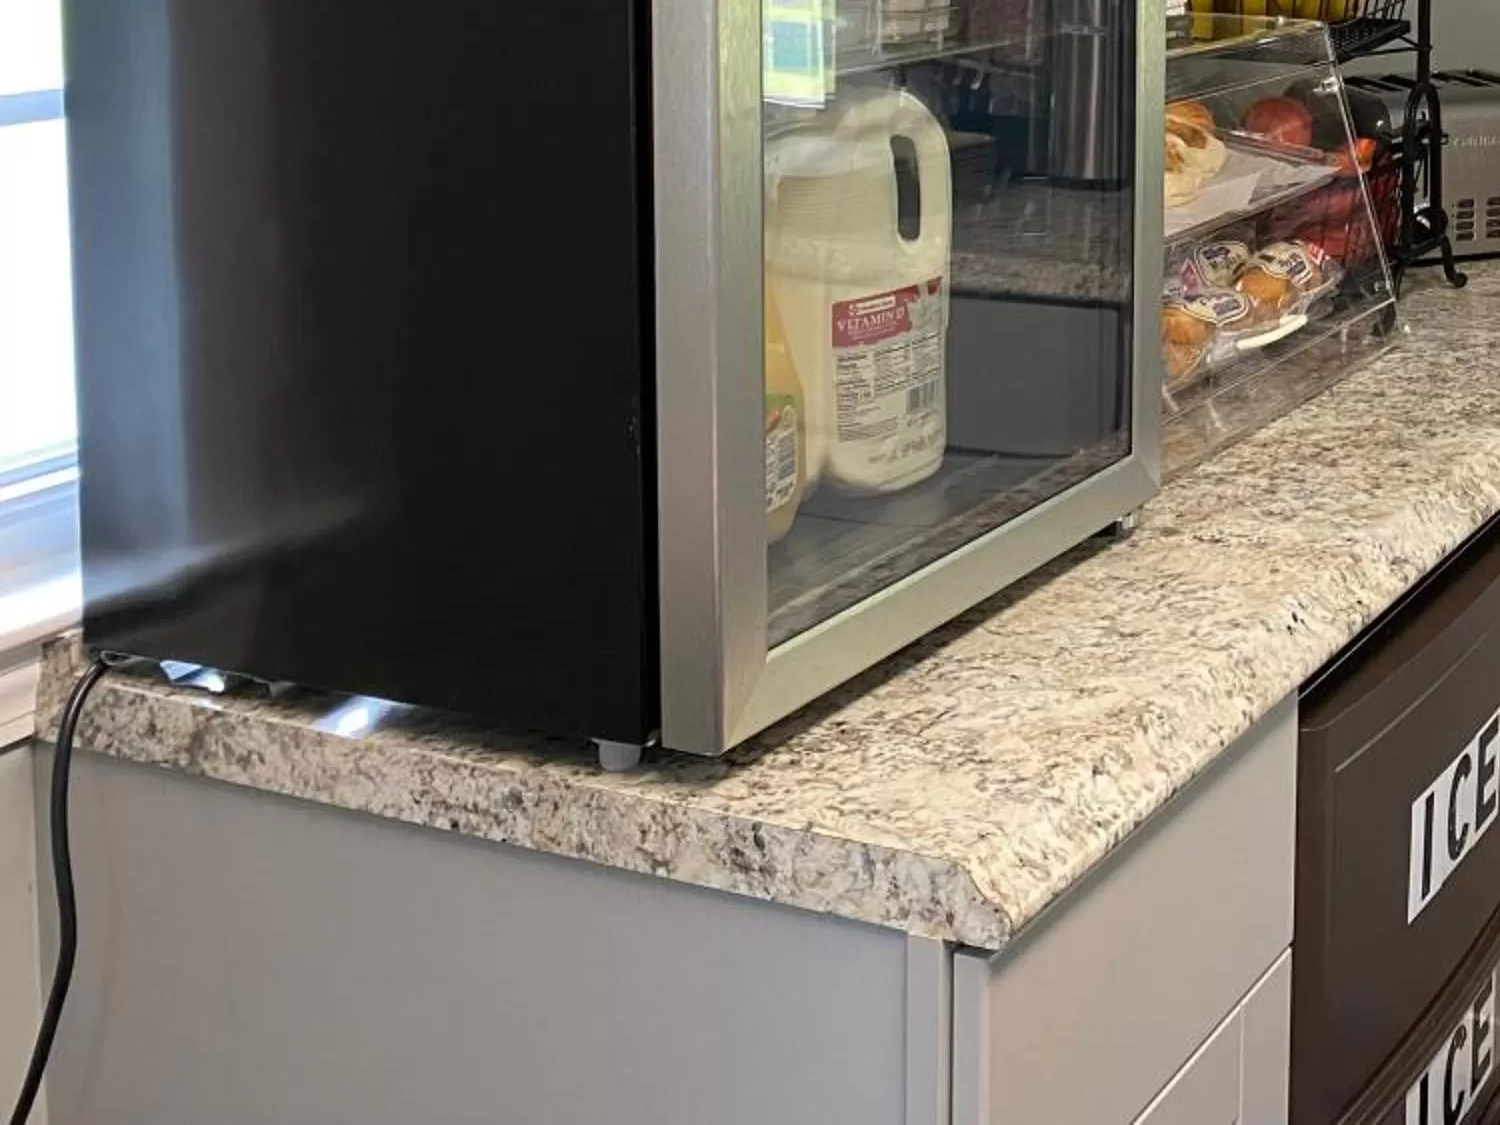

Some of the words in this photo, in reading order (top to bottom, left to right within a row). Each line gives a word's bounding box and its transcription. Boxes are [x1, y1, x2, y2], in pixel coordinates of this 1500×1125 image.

[837, 311, 895, 331] VITAMIN
[1422, 714, 1499, 901] ICE
[1419, 977, 1492, 1125] ICE
